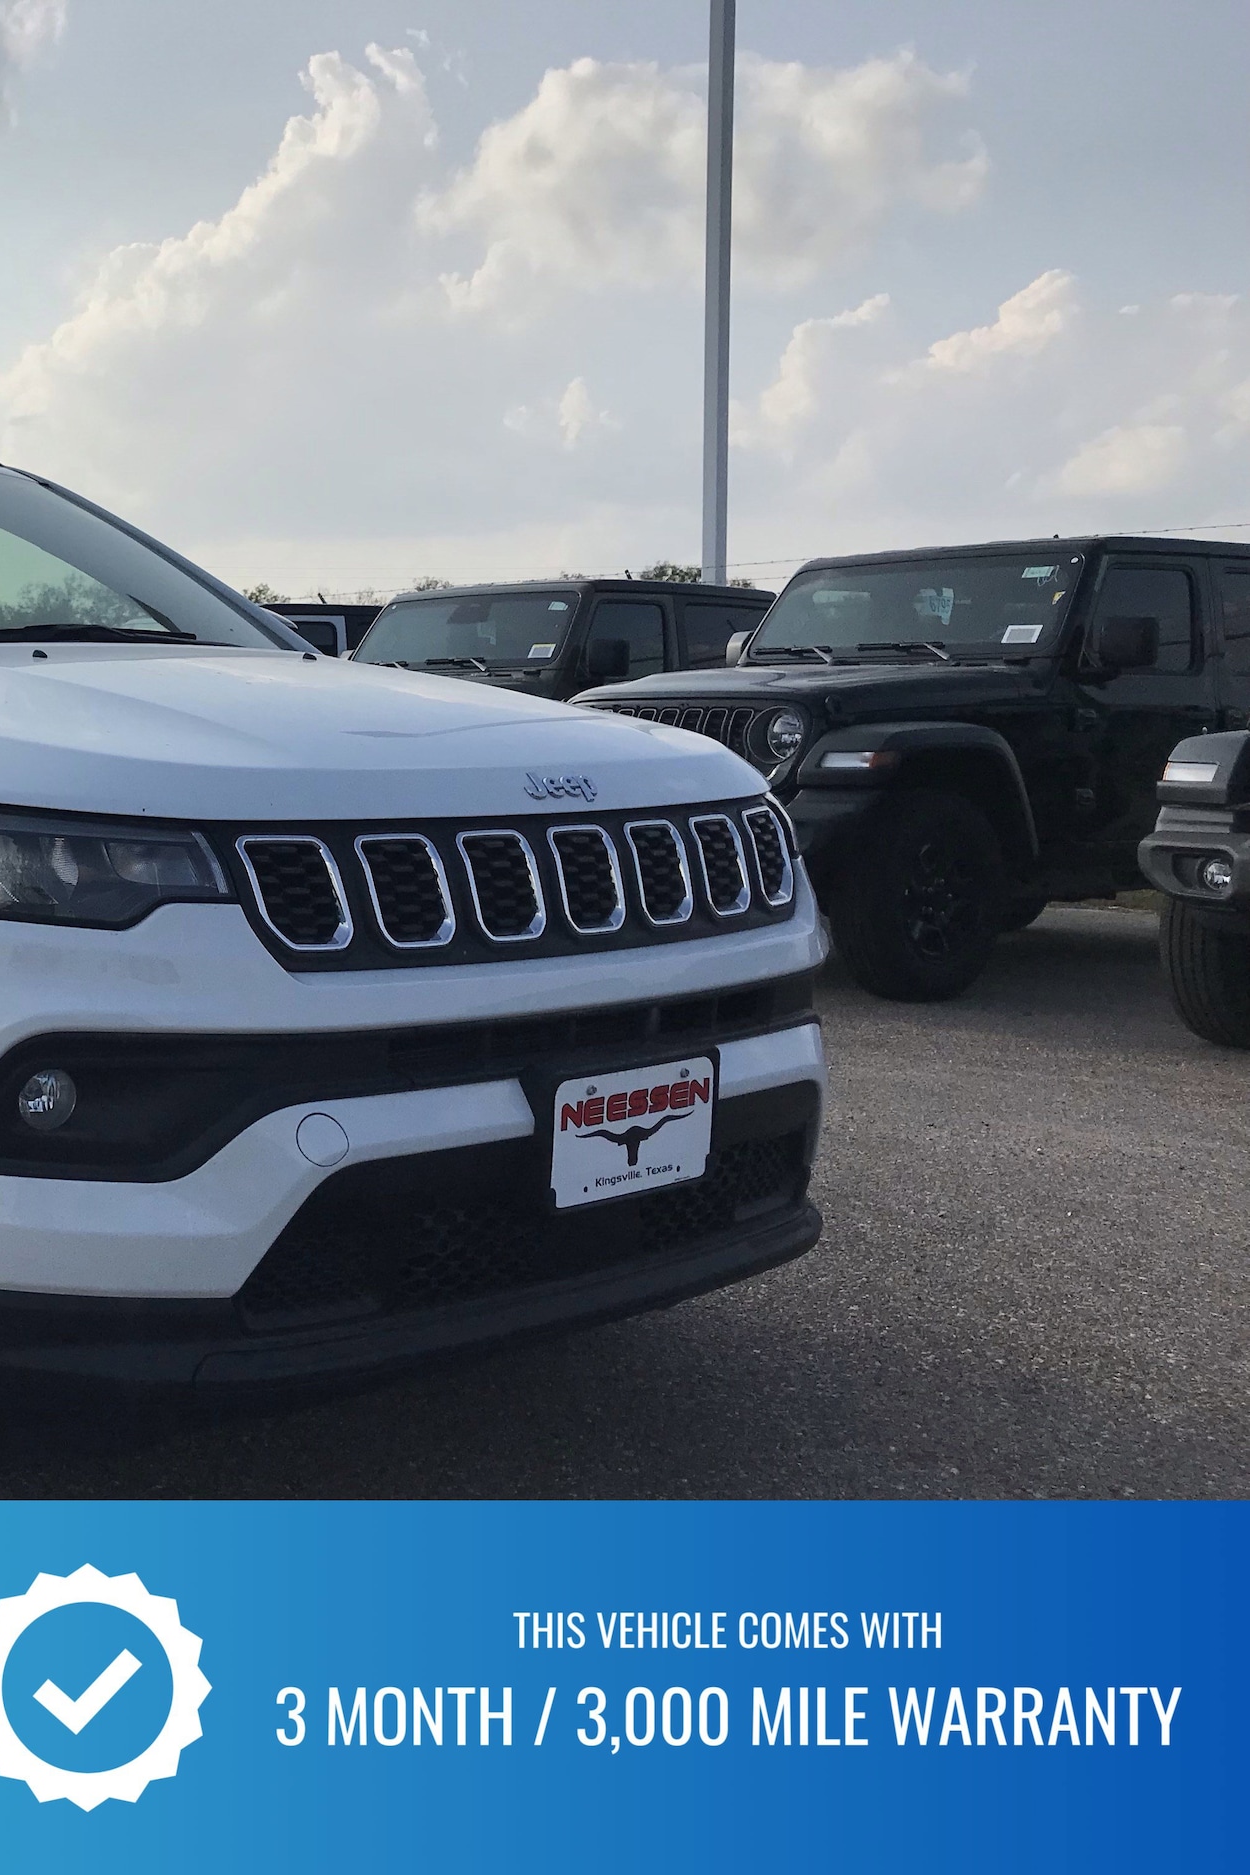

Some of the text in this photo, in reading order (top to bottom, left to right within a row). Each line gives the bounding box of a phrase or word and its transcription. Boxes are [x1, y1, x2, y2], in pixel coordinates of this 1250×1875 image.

[523, 771, 598, 803] Jeep
[560, 1077, 710, 1131] NEESSEN
[646, 1164, 673, 1177] Texas
